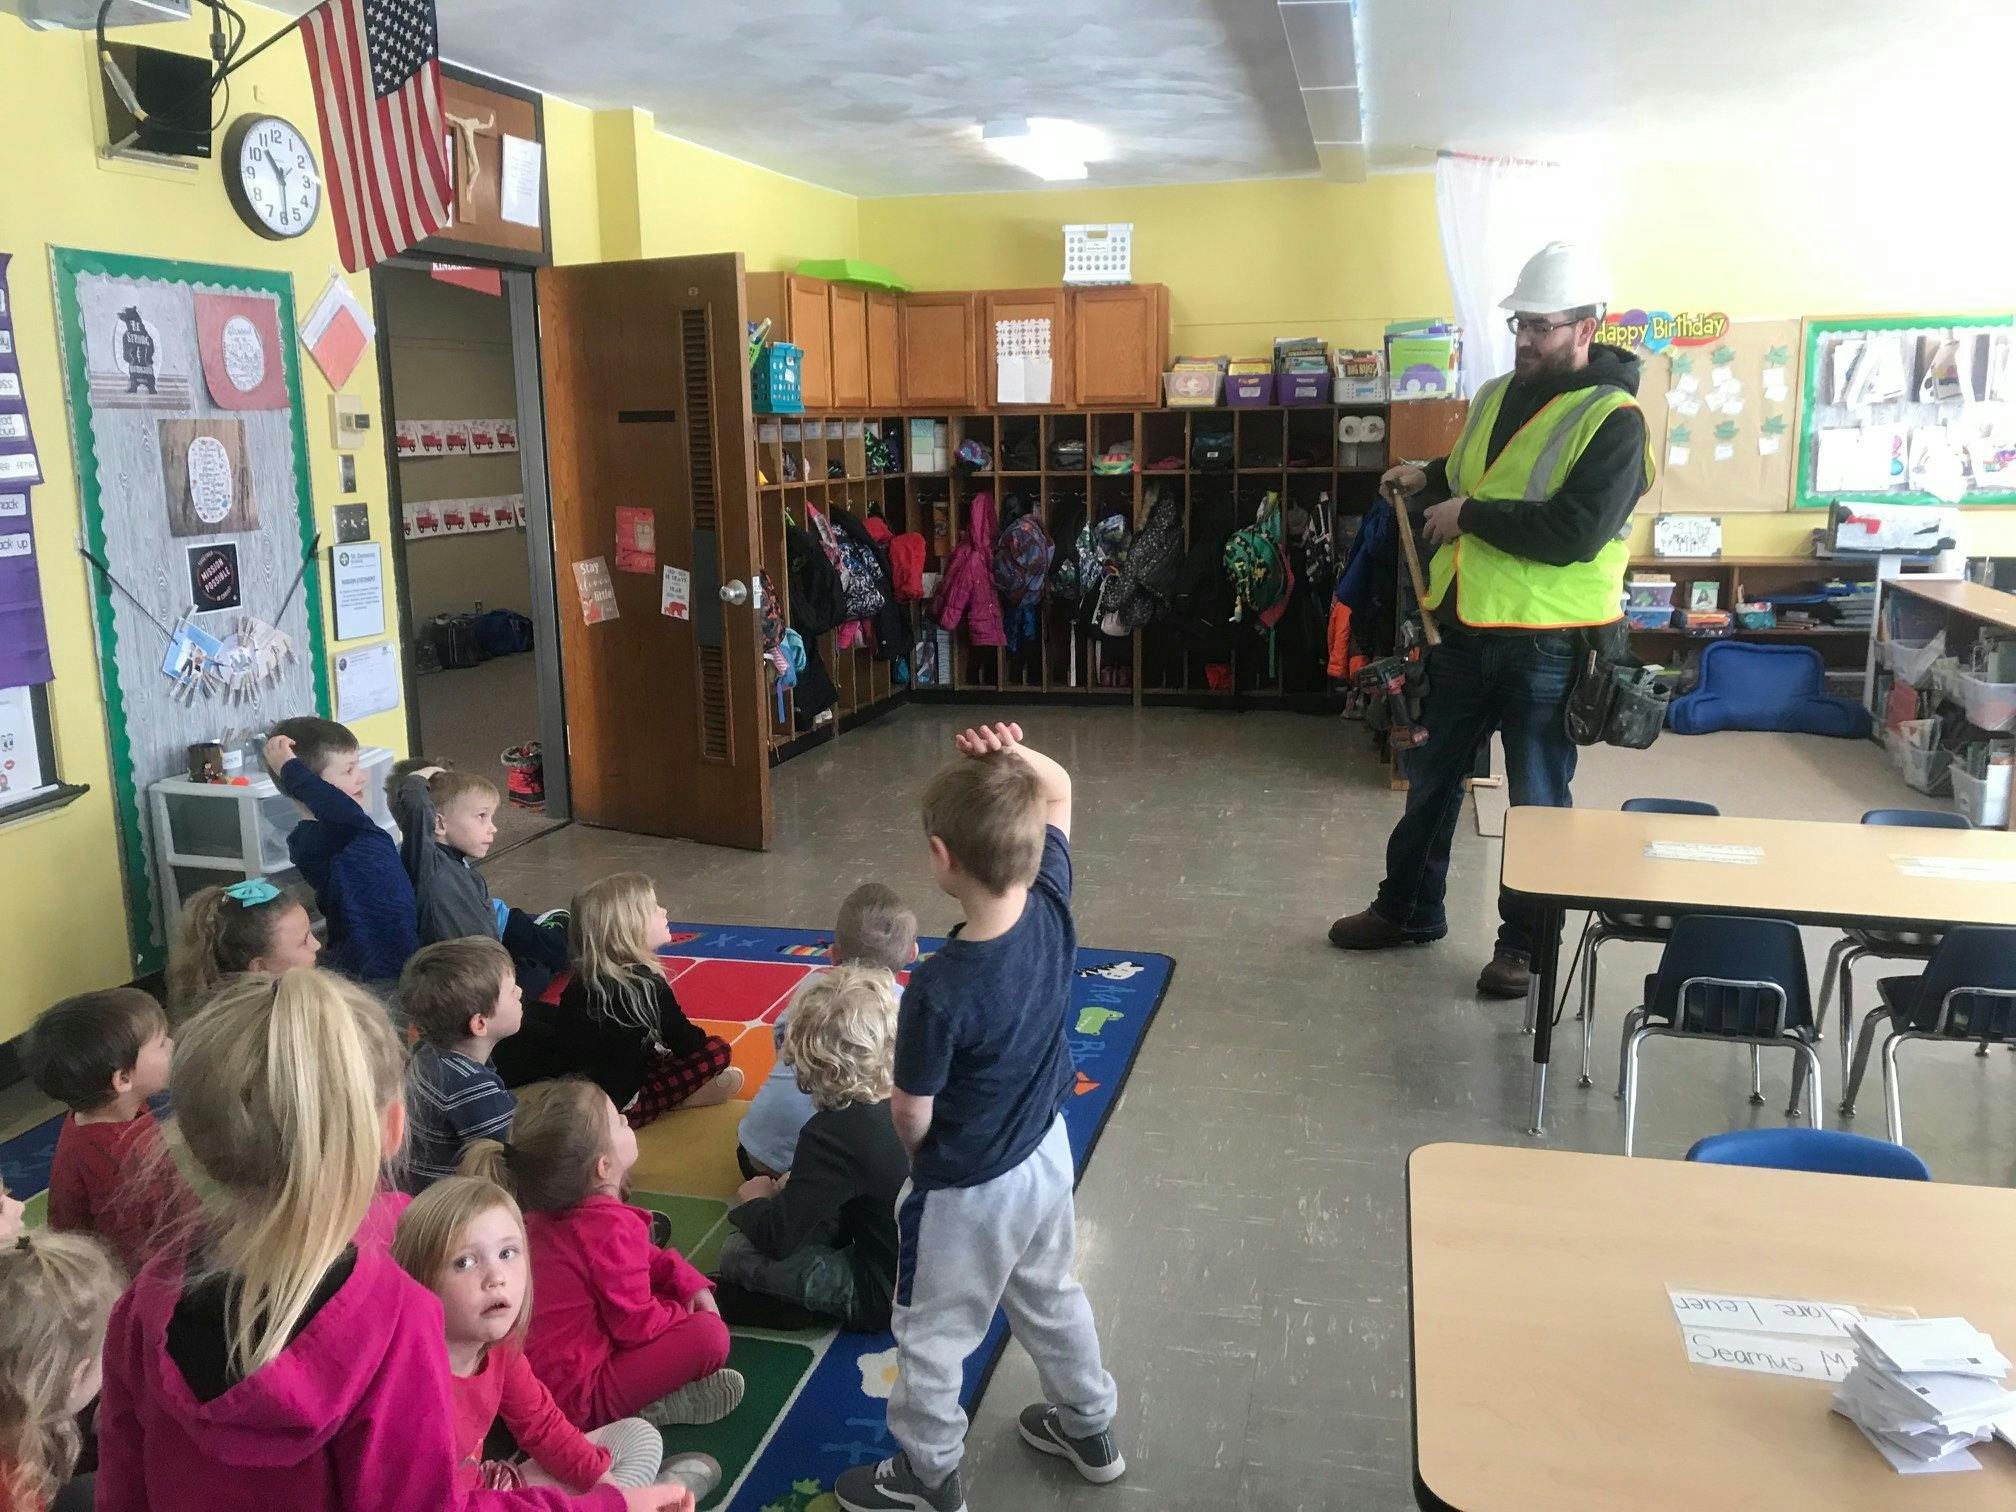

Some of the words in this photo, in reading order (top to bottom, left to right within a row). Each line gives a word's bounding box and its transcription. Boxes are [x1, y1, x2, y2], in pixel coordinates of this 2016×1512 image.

[259, 133, 268, 147] 11
[270, 129, 282, 144] 12
[288, 138, 293, 152] 1
[249, 147, 262, 161] 10
[296, 154, 305, 169] 2
[246, 165, 255, 179] 9
[302, 175, 311, 189] 3
[253, 187, 262, 201] 8
[300, 195, 308, 208] 4
[265, 204, 274, 217] 7
[292, 207, 302, 221] 5
[280, 211, 288, 225] 6
[1652, 313, 1725, 339] Birthday
[17, 539, 28, 550] up
[200, 557, 224, 581] MISSION
[580, 561, 599, 574] Stay
[204, 566, 230, 593] POSSIBLE
[594, 588, 612, 602] little
[1692, 1334, 1804, 1373] Seamus
